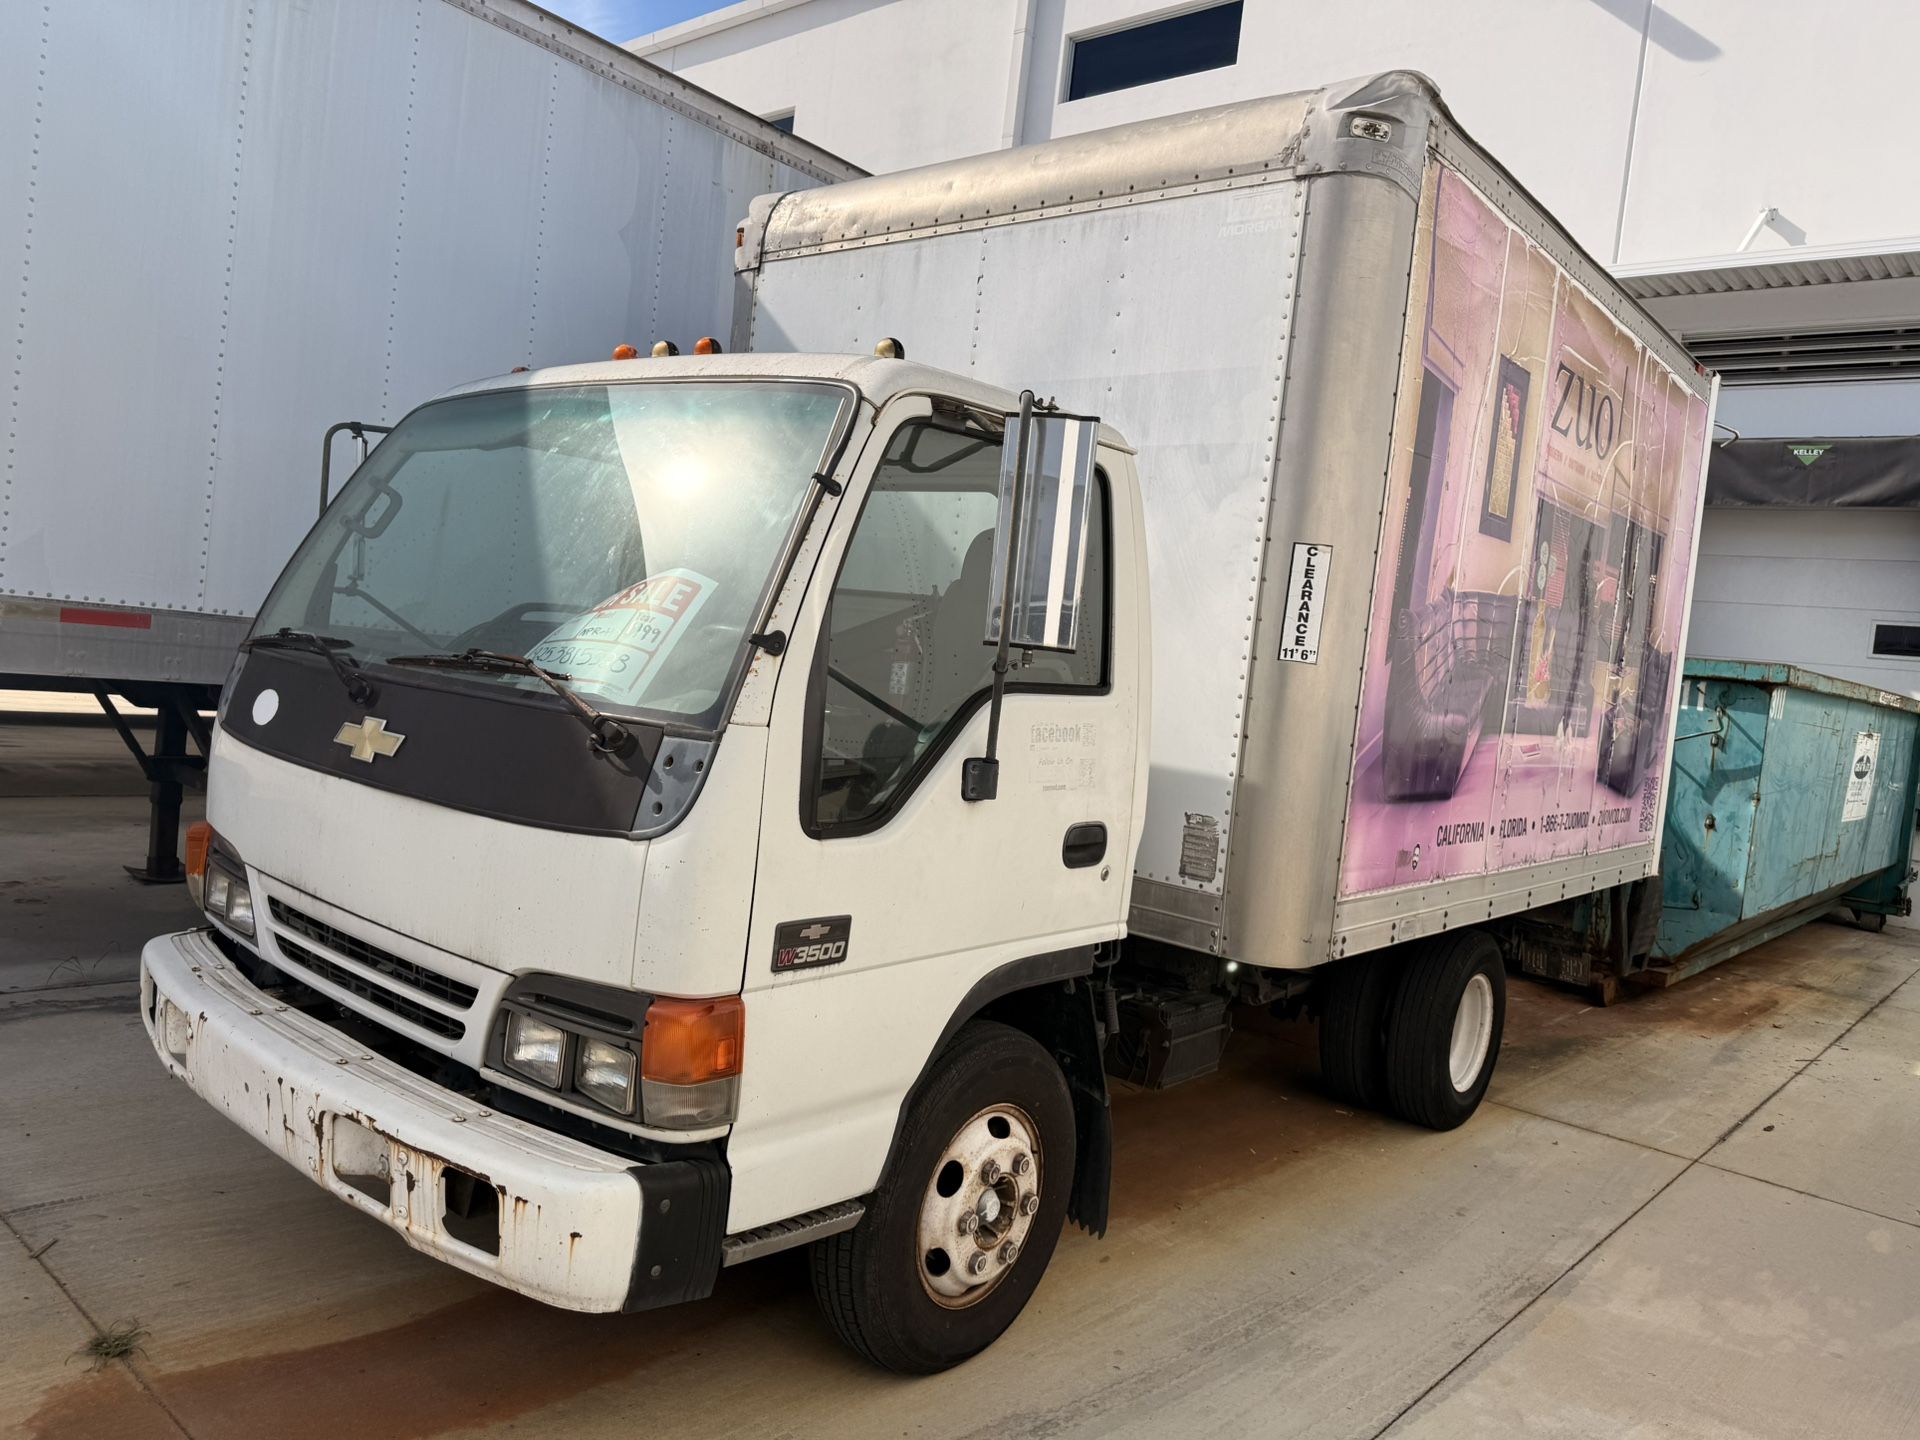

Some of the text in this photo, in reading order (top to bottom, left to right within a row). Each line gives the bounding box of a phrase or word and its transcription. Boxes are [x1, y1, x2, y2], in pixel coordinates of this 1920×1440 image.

[619, 580, 692, 611] SALE
[1295, 546, 1318, 646] CLEARANCE
[1436, 821, 1485, 847] CALIFORNIA
[1499, 817, 1527, 839] FLORIDA
[777, 941, 846, 967] W3500
